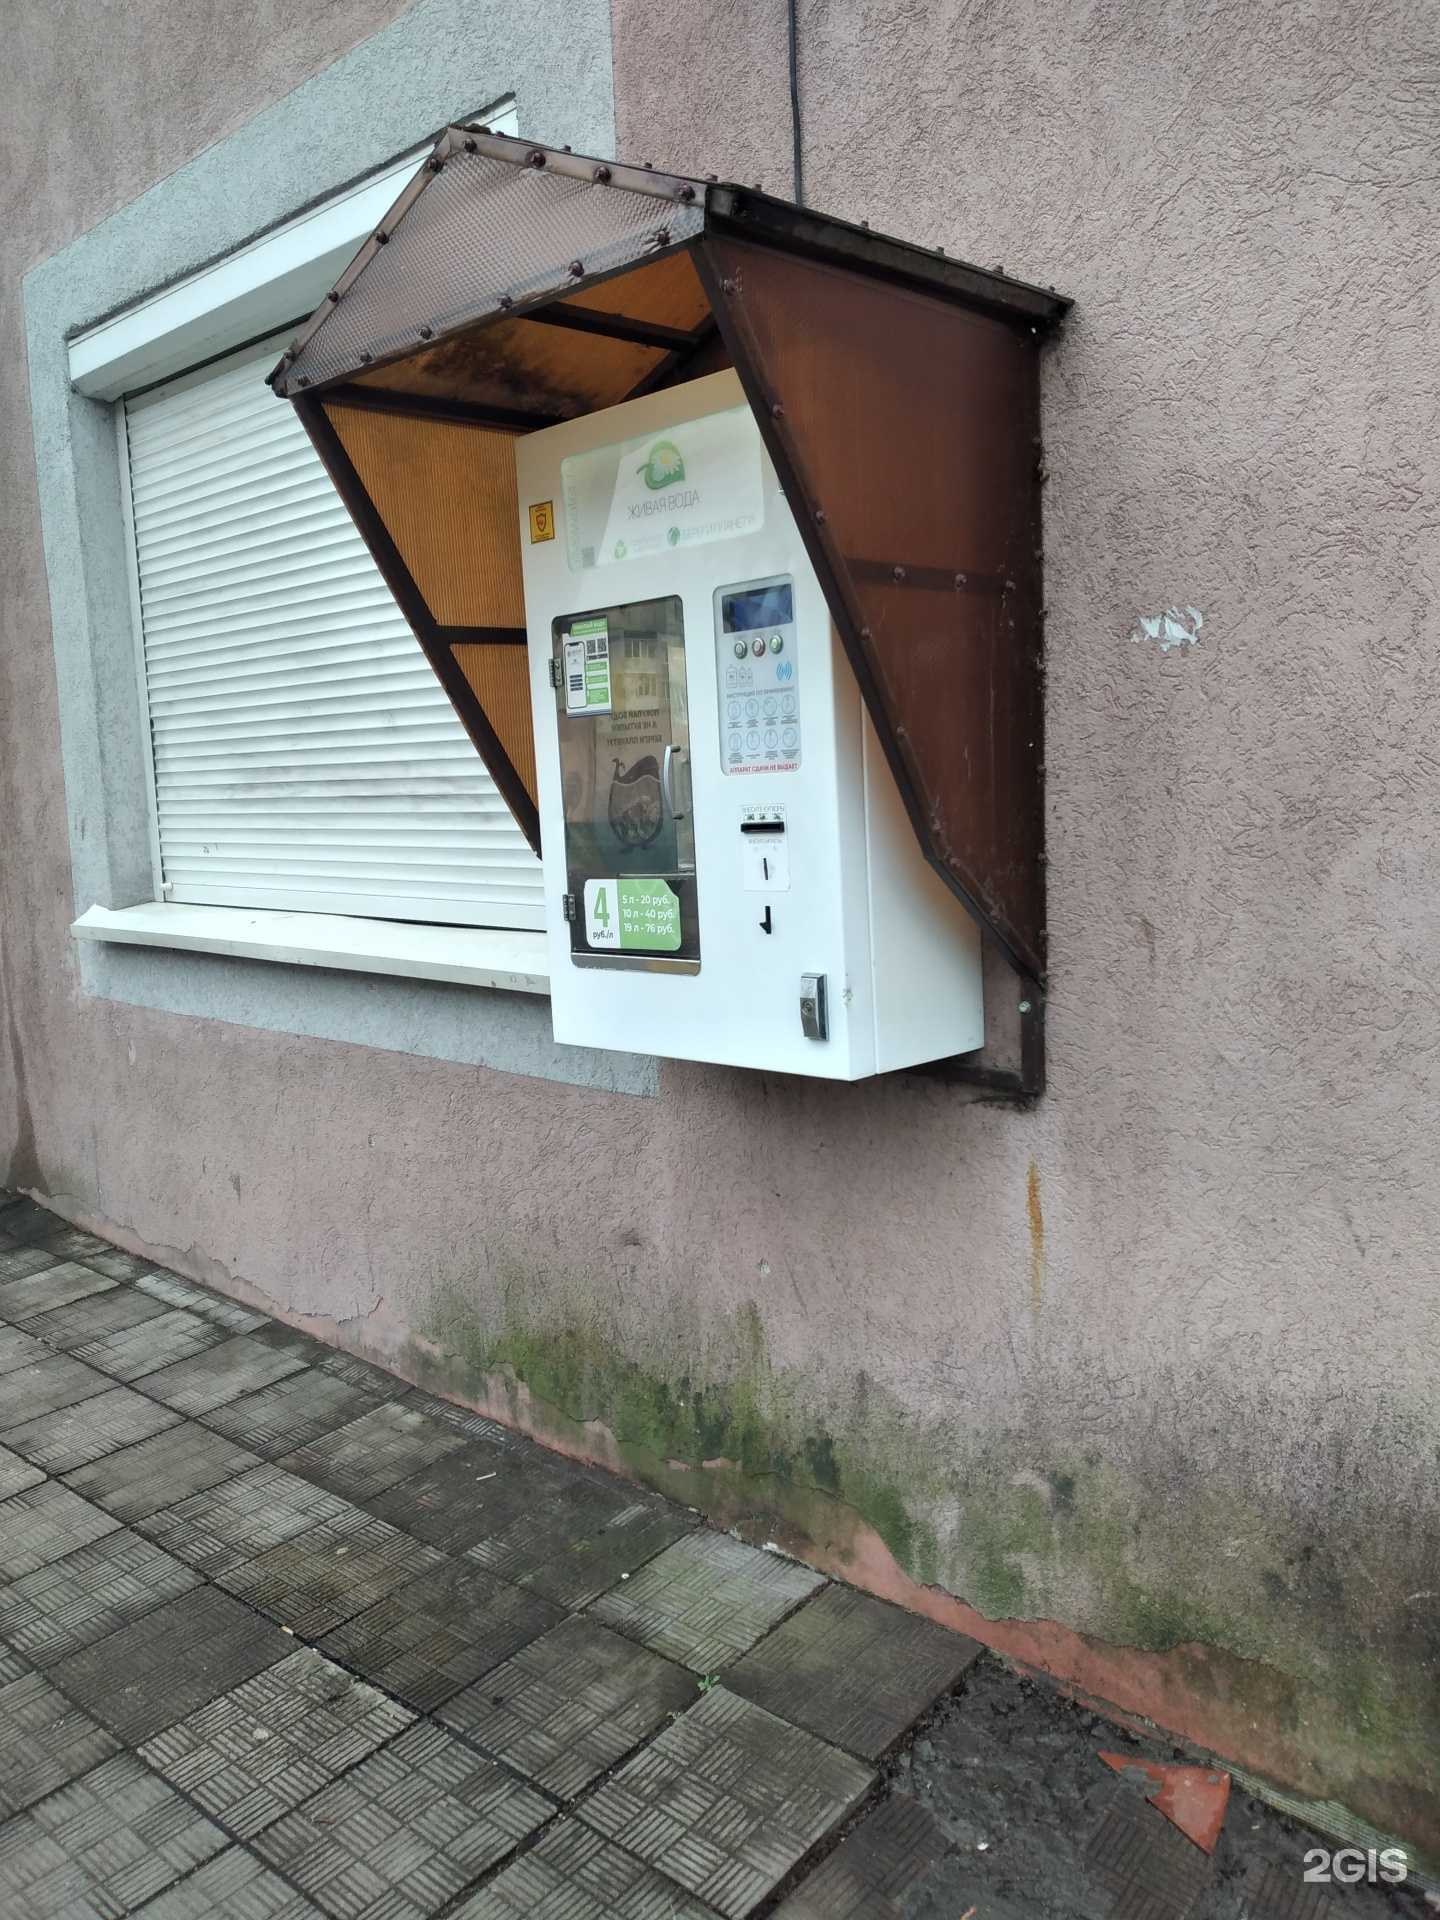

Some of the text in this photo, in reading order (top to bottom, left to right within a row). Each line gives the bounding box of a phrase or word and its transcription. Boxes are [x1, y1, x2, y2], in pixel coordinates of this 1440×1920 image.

[627, 489, 700, 520] ЖИВАЯ ВОДА
[622, 895, 628, 904] 5
[640, 895, 651, 904] 20
[652, 895, 670, 906] руб.
[593, 887, 610, 928] 4
[623, 909, 631, 918] 10
[645, 909, 656, 918] 40
[657, 910, 674, 920] руб.
[593, 930, 614, 939] руб./л
[624, 923, 632, 932] 19
[646, 924, 656, 933] 76
[657, 924, 674, 935] руб.
